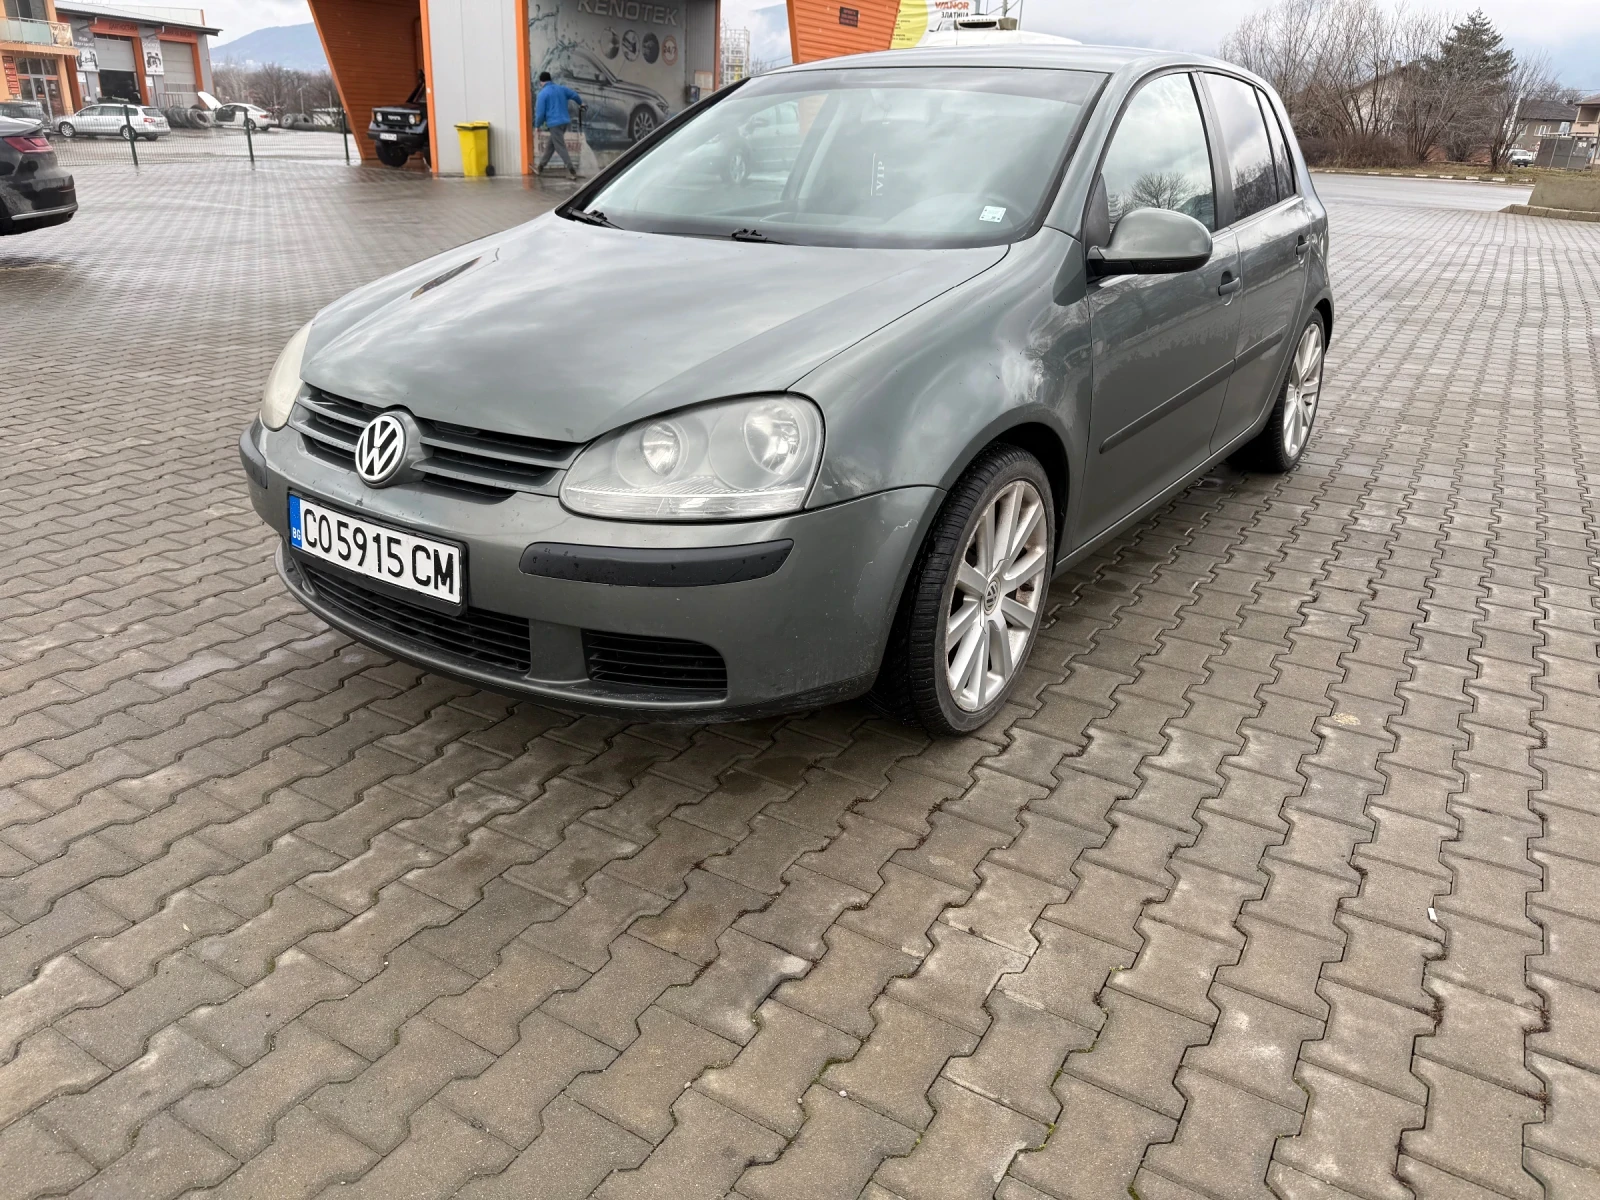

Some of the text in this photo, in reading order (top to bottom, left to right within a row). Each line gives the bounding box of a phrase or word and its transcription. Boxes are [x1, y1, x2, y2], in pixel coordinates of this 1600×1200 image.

[577, 0, 678, 26] KENOTEK
[292, 527, 302, 541] BG
[336, 519, 405, 578] 5915
[411, 544, 454, 595] CM
